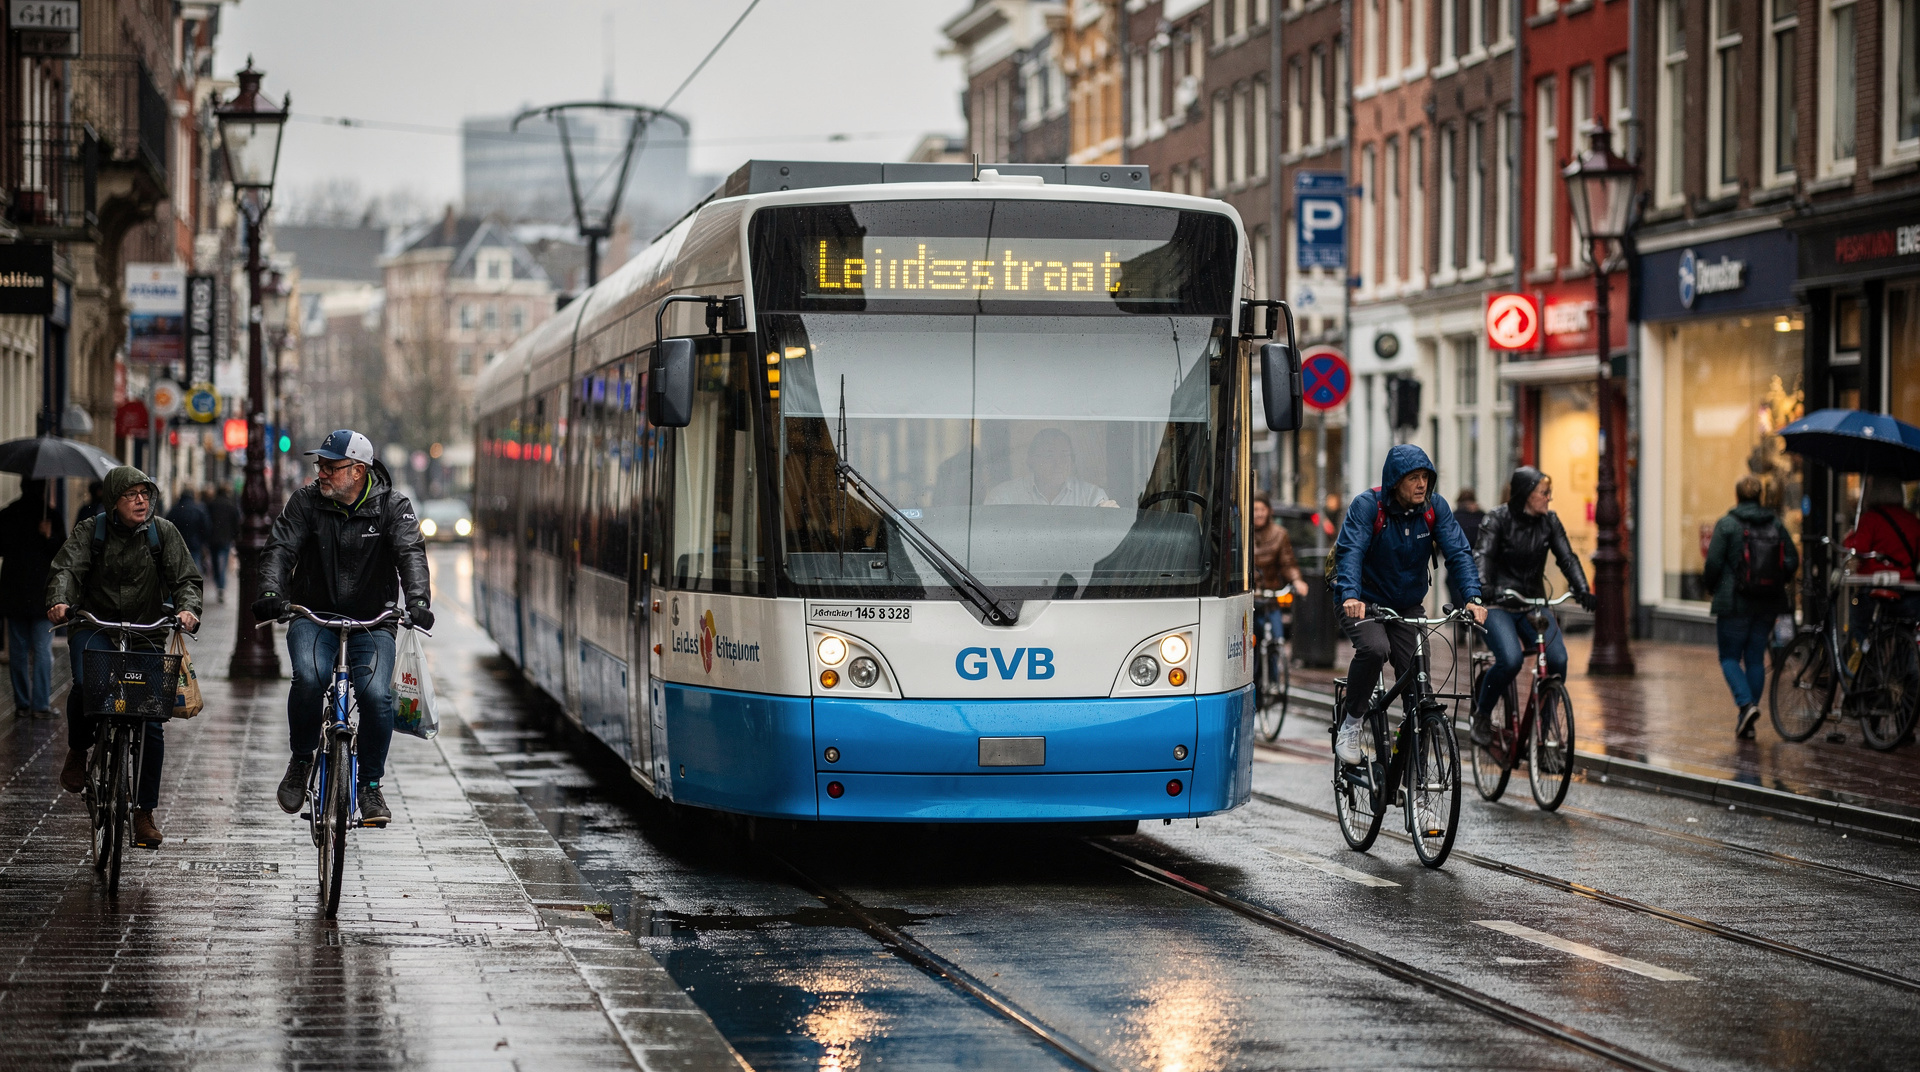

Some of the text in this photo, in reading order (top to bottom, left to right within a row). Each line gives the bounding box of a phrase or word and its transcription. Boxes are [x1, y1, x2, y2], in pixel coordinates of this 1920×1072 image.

[1302, 199, 1343, 242] P
[855, 607, 876, 619] 145
[955, 646, 1056, 681] GVB
